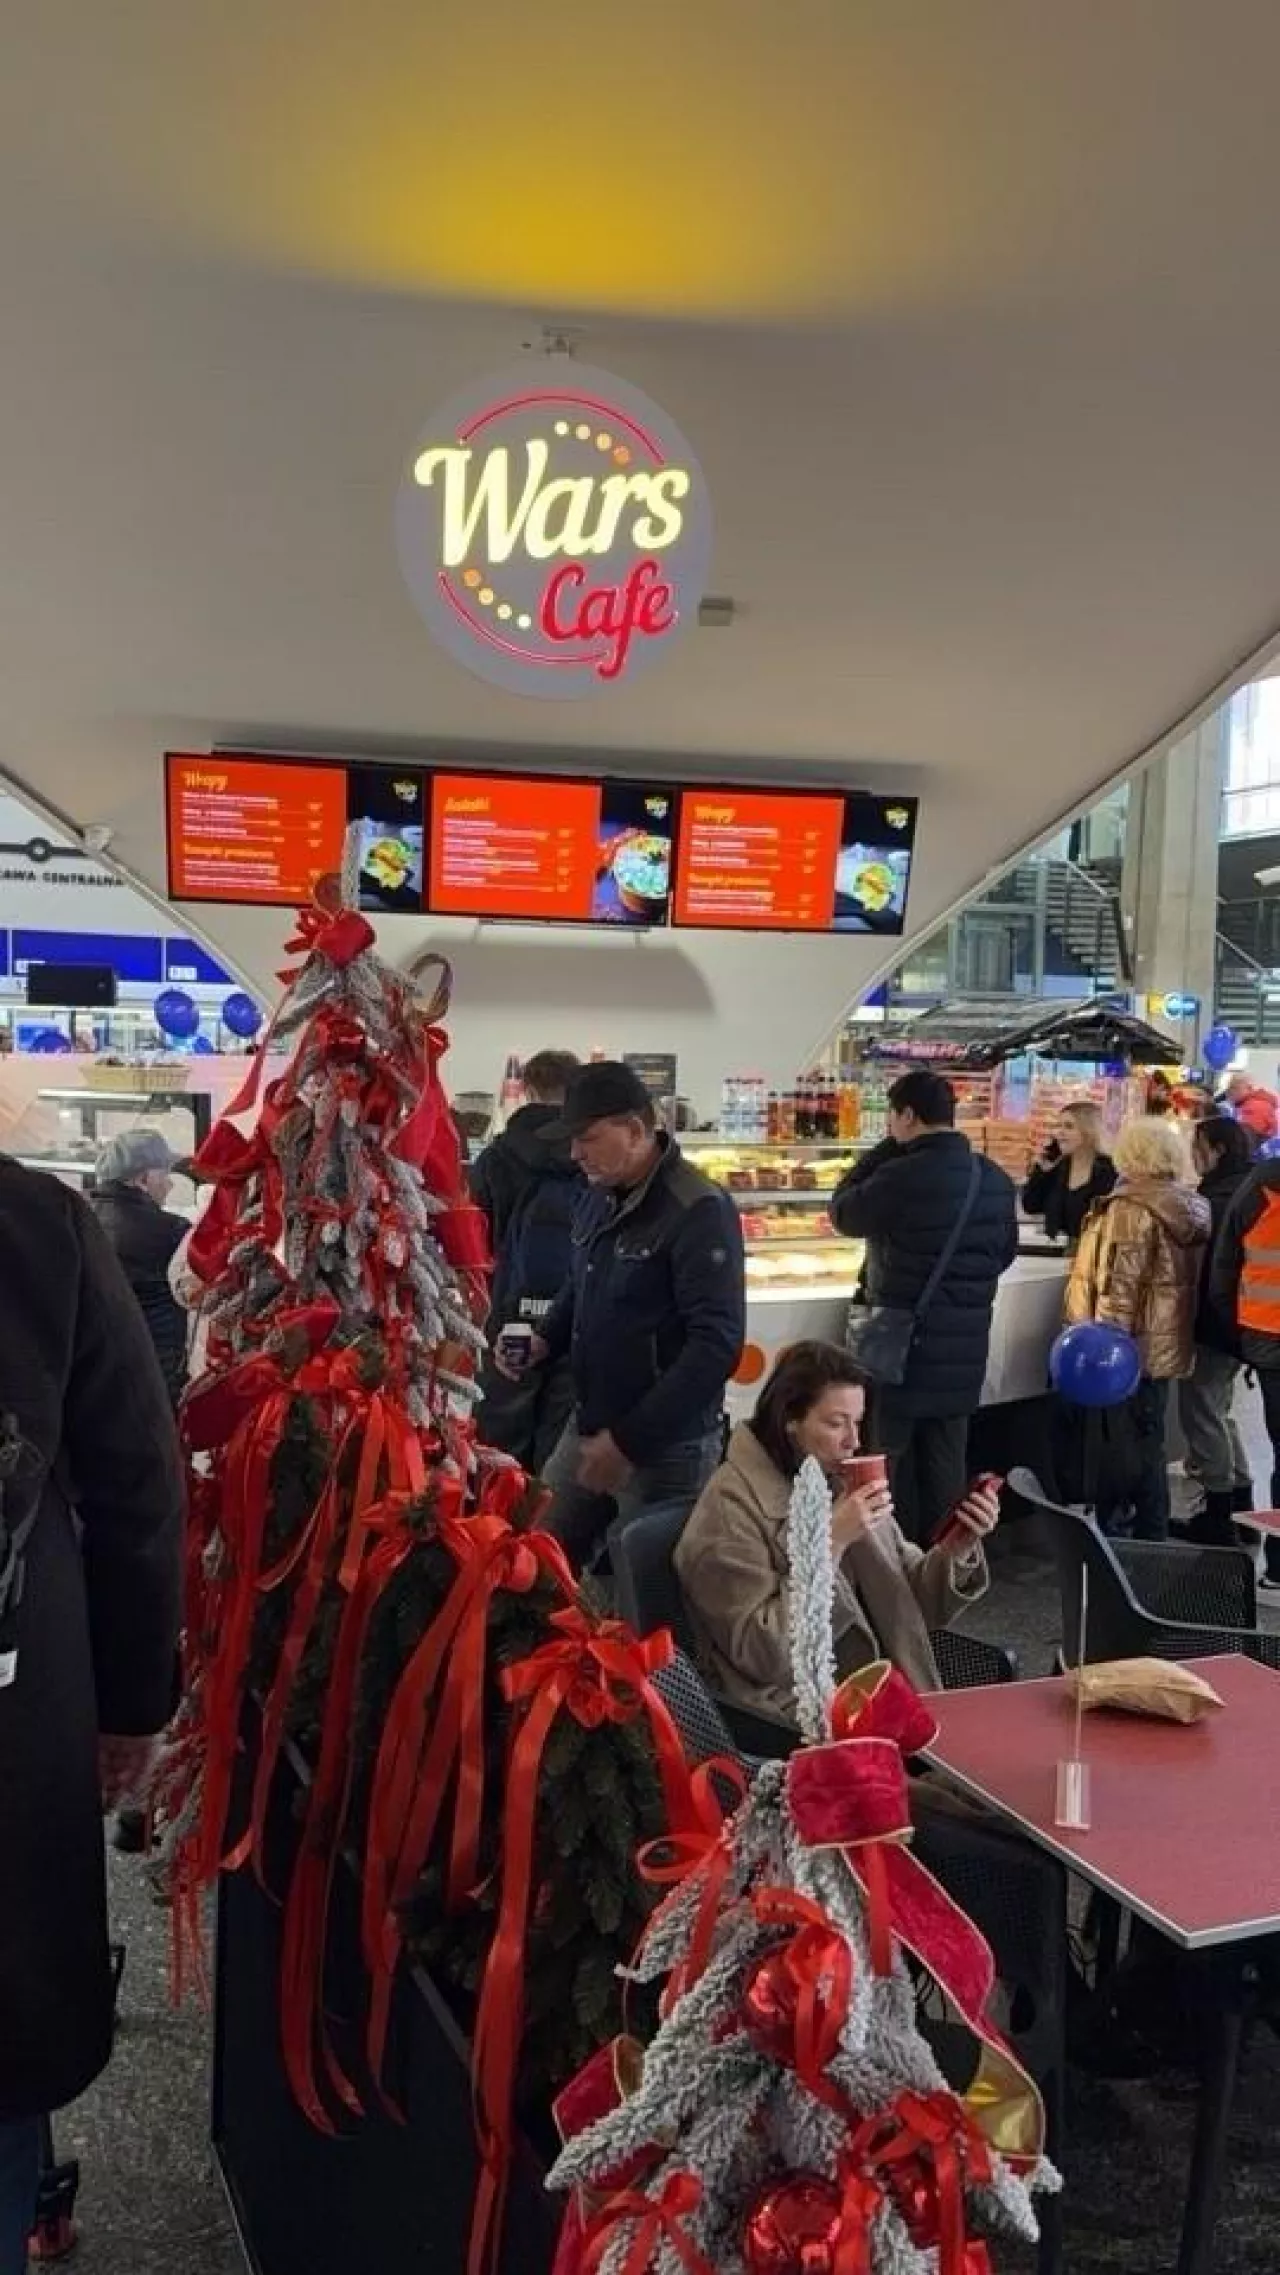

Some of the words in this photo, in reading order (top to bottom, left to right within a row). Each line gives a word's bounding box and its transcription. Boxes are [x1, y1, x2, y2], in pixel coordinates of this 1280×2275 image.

[413, 438, 690, 568] Wars
[542, 558, 678, 679] Cafe
[0, 869, 37, 881] AWA
